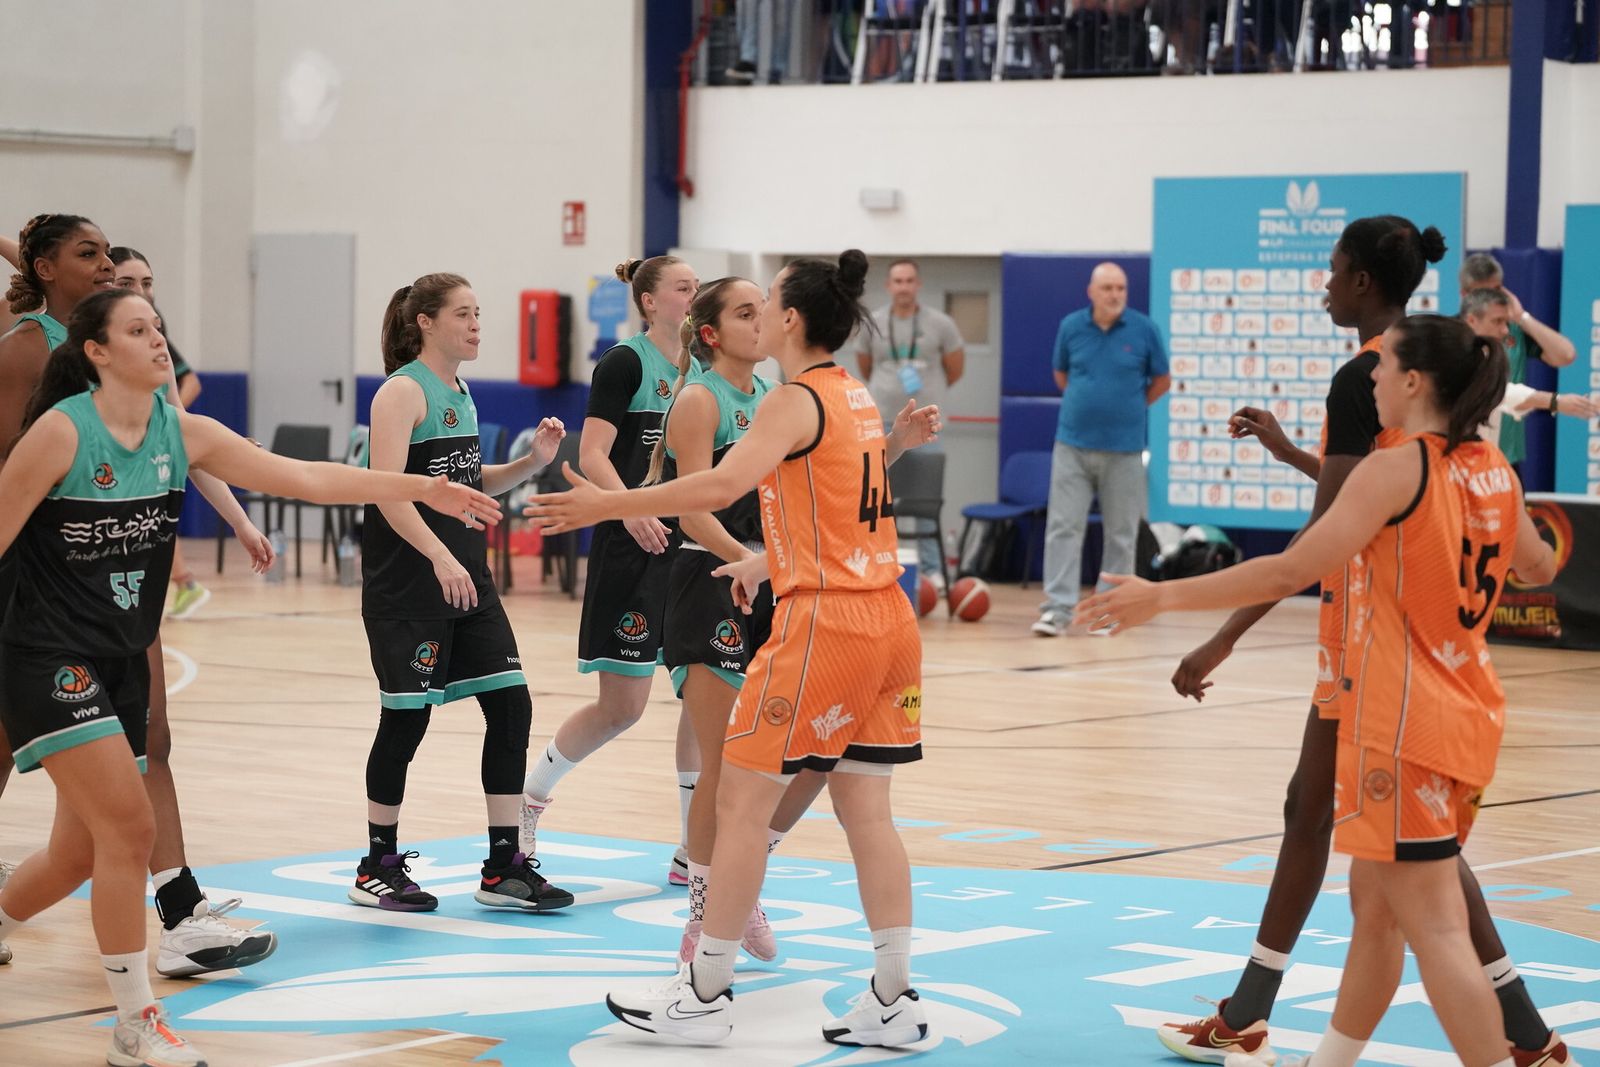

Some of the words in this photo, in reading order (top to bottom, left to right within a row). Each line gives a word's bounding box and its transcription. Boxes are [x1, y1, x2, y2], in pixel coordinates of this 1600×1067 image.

[1259, 218, 1297, 235] FINAL
[1301, 218, 1345, 235] FOUR
[109, 569, 146, 611] 55
[620, 647, 641, 658] vive
[720, 659, 741, 670] vive
[72, 706, 100, 720] vive
